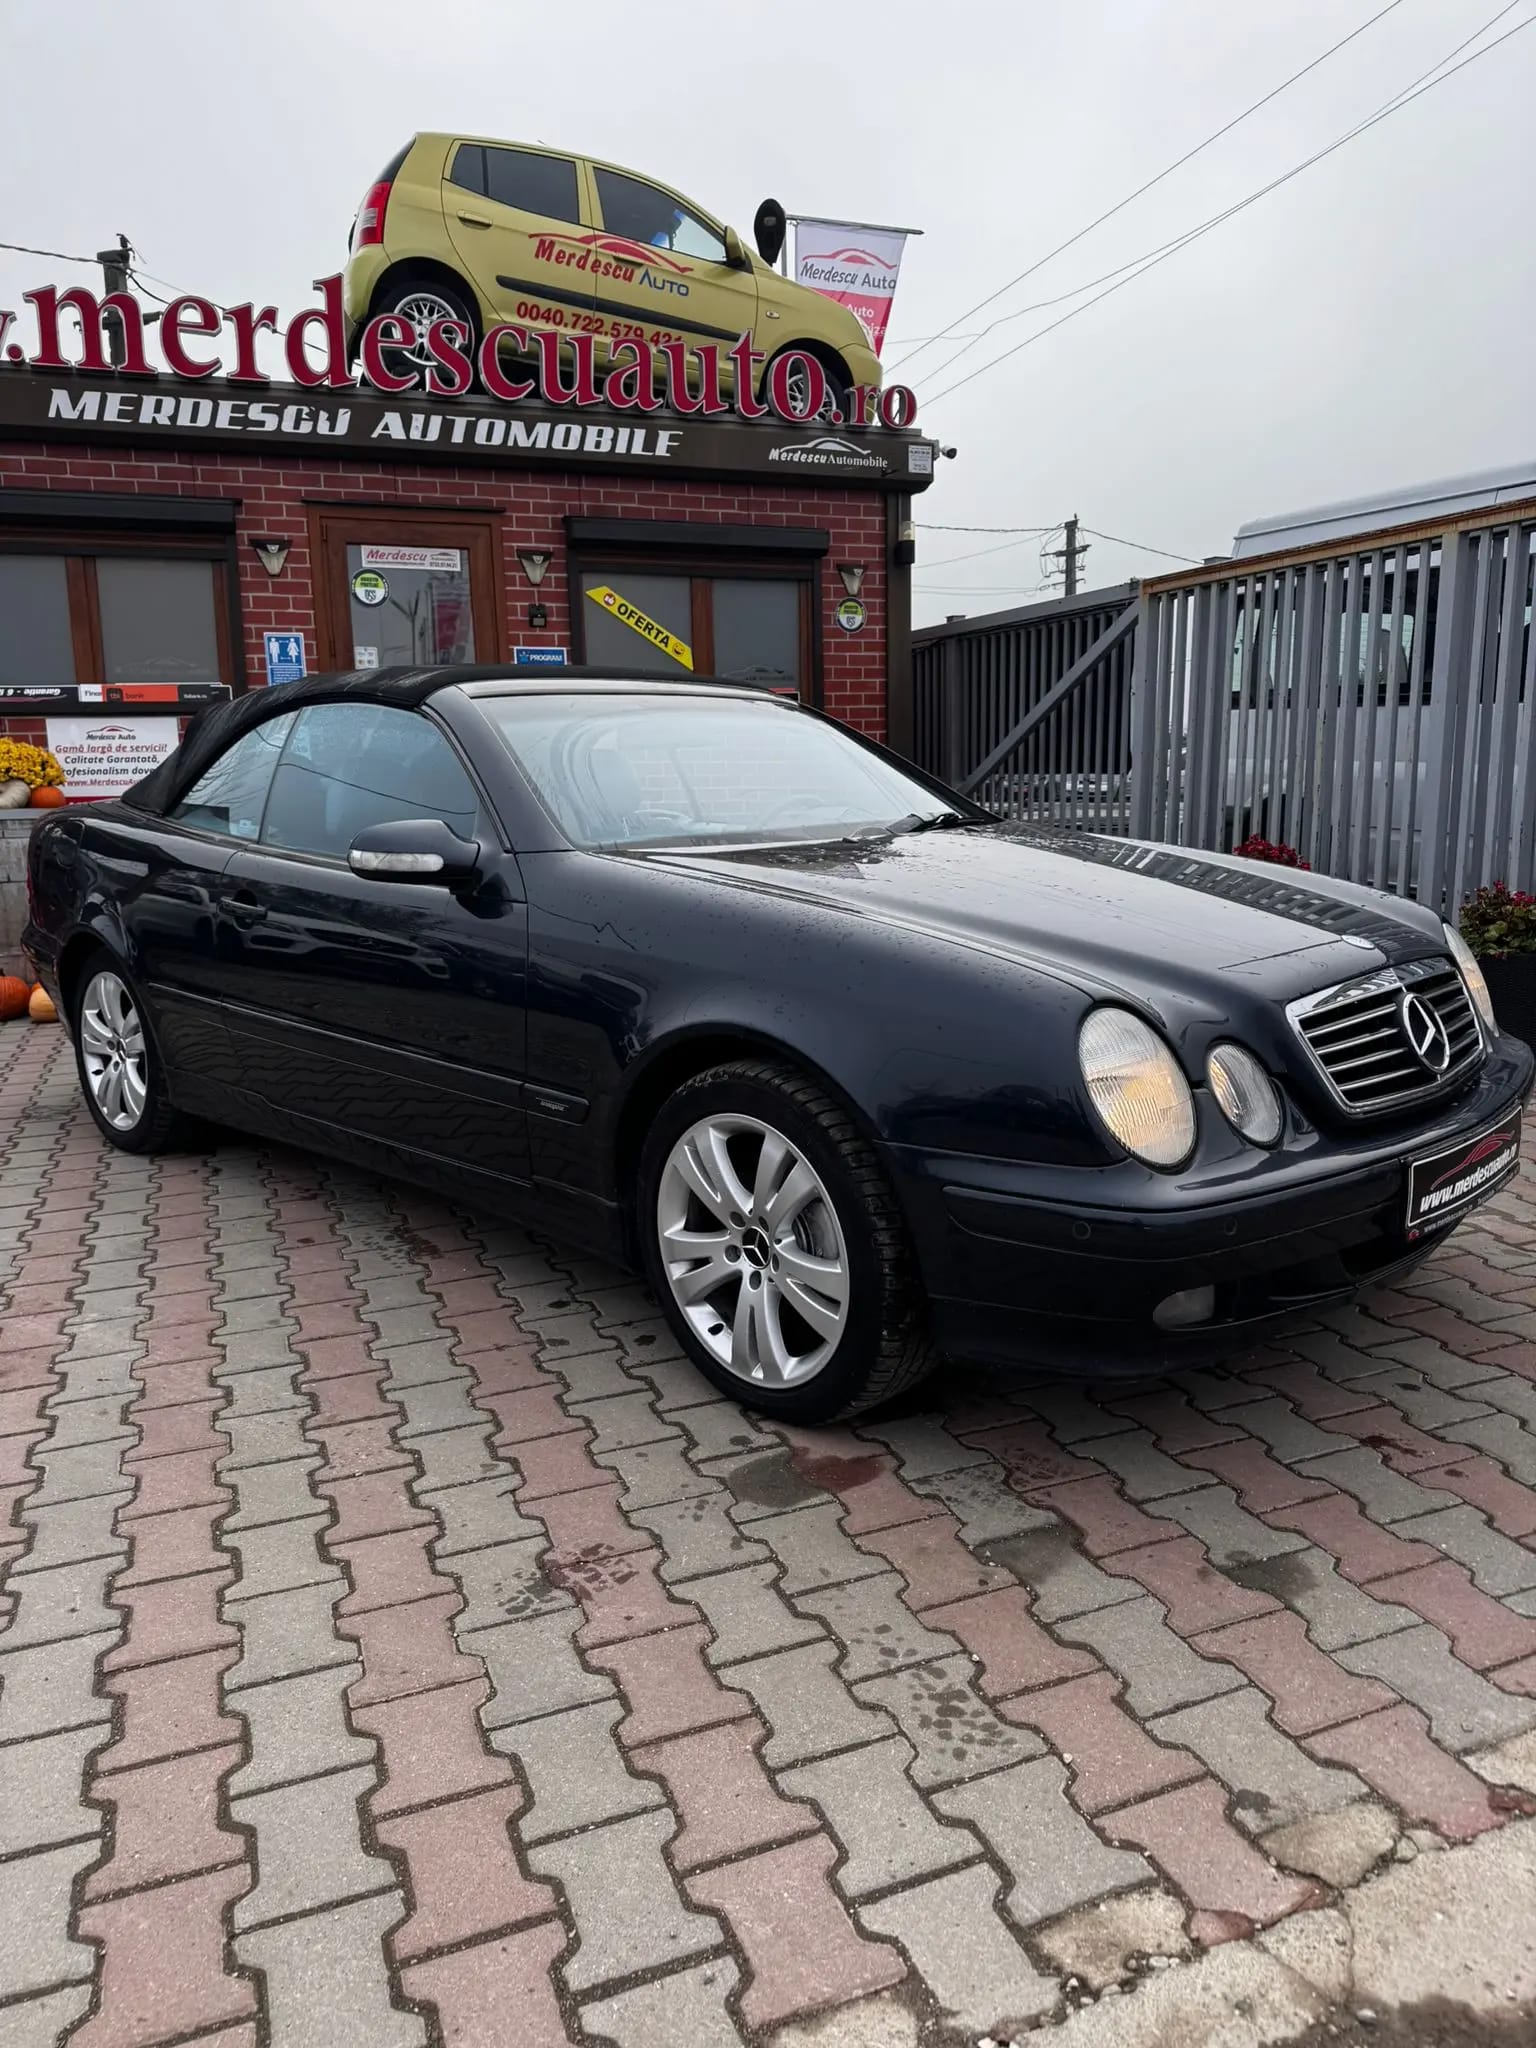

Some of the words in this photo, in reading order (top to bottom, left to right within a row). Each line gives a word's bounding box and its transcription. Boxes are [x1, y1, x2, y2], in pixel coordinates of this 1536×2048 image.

[534, 238, 635, 283] Merdescu
[639, 268, 689, 297] AUTO
[800, 261, 858, 285] Merdescu
[861, 273, 897, 290] Auto
[0, 272, 918, 429] .merdescuauto.ro
[48, 388, 351, 437] MERDESCU
[370, 411, 684, 457] AUTOMOBILE
[367, 549, 427, 562] Merdescu
[617, 603, 670, 648] OFERTA
[530, 654, 562, 662] PROGRAM
[64, 755, 104, 764] Calitate
[115, 743, 127, 753] de
[130, 743, 167, 753] servicii!
[62, 767, 129, 777] rofesionalism
[132, 766, 153, 775] dov
[1420, 1143, 1517, 1212] www.merdescuauto.ro
